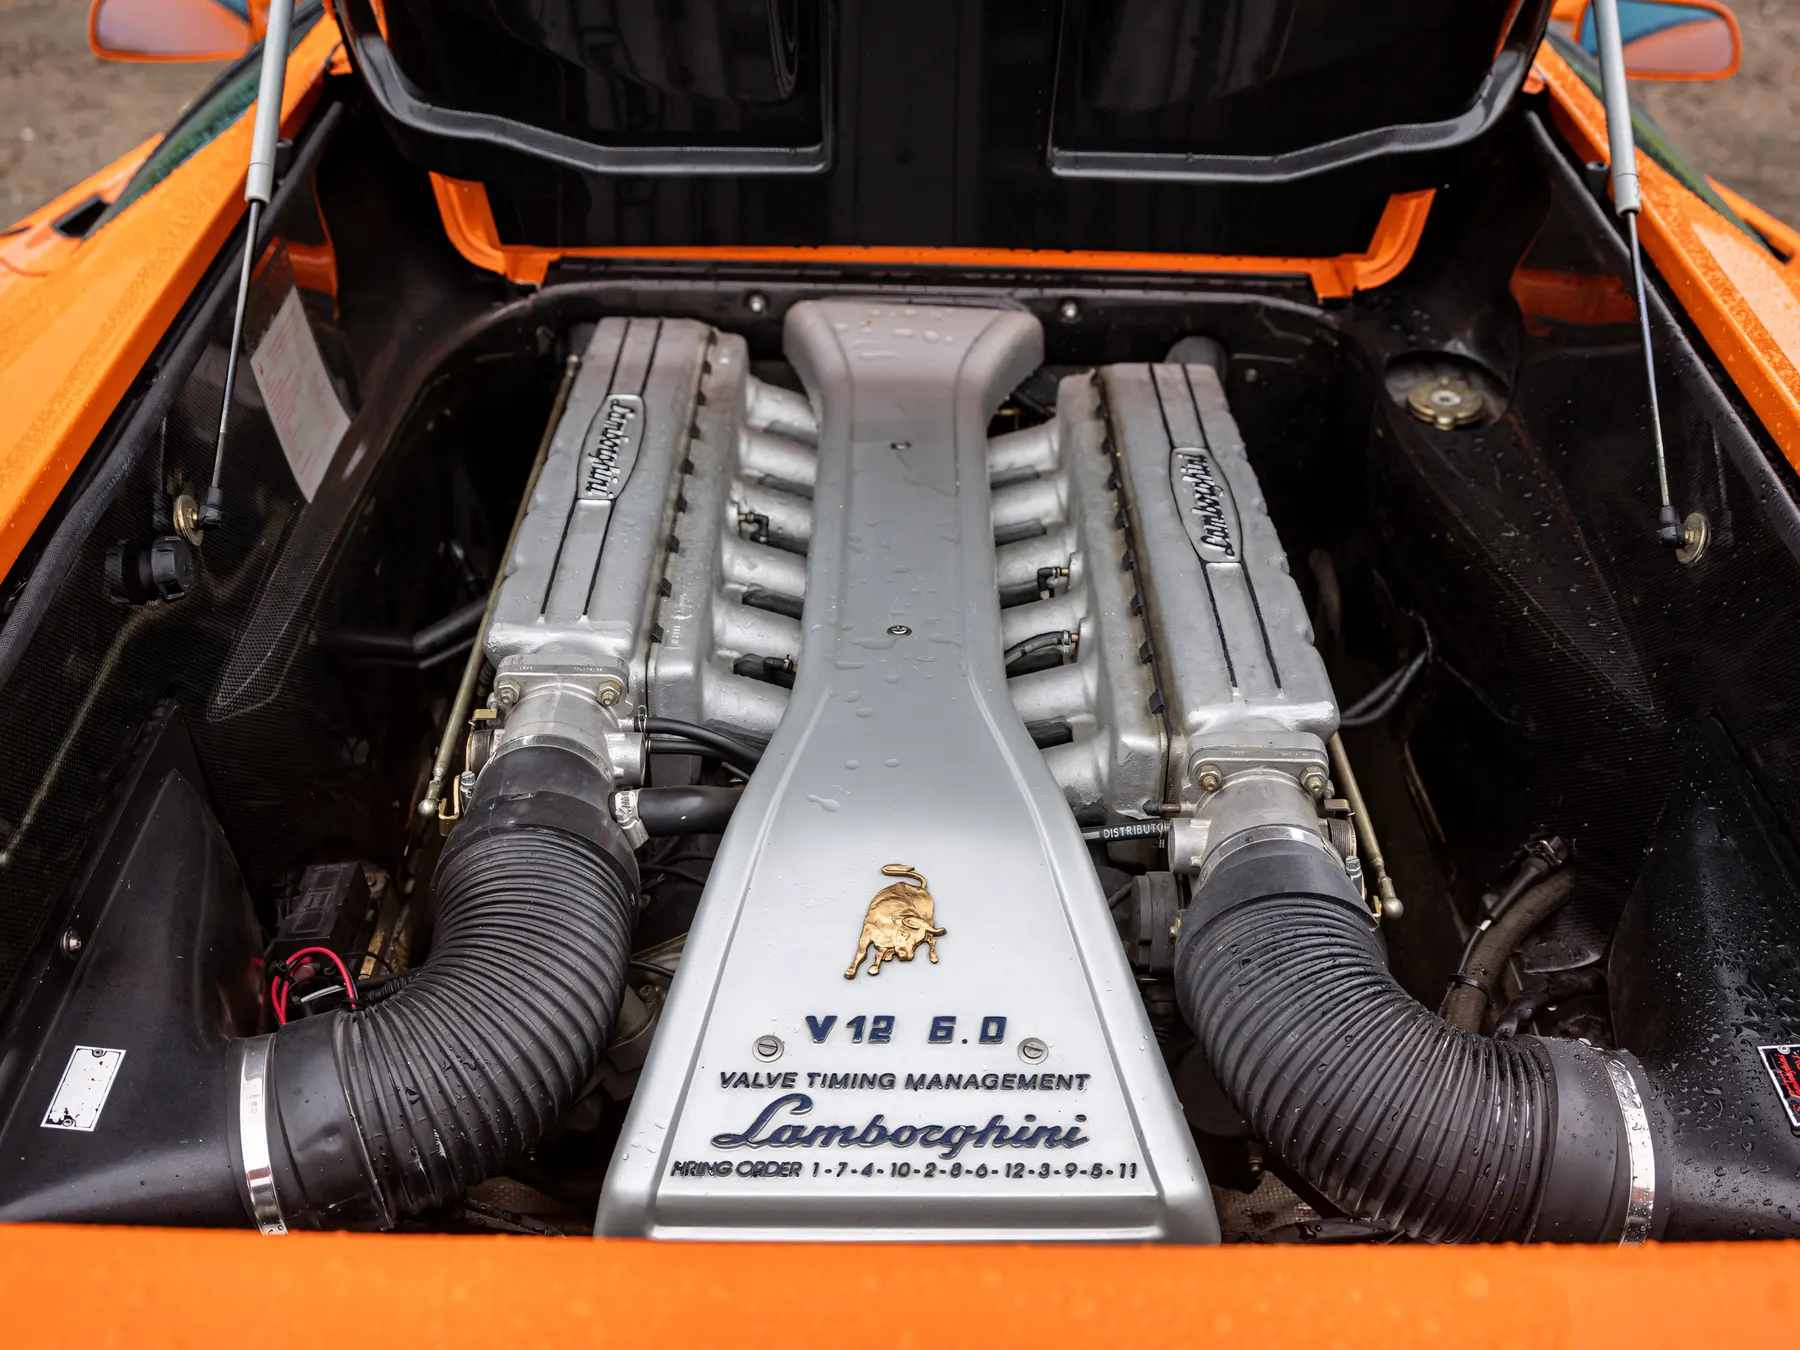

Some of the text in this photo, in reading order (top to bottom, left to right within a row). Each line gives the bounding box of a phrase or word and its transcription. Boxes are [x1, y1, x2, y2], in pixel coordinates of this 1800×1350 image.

[586, 399, 634, 498] Lamborghini
[1178, 453, 1235, 557] Lamborghini
[927, 1015, 1008, 1045] 6.0
[720, 1072, 1091, 1092] VALVE TIMING MANAGEMENT
[710, 1092, 1091, 1161] Lamborghini
[734, 1160, 803, 1179] ORDER
